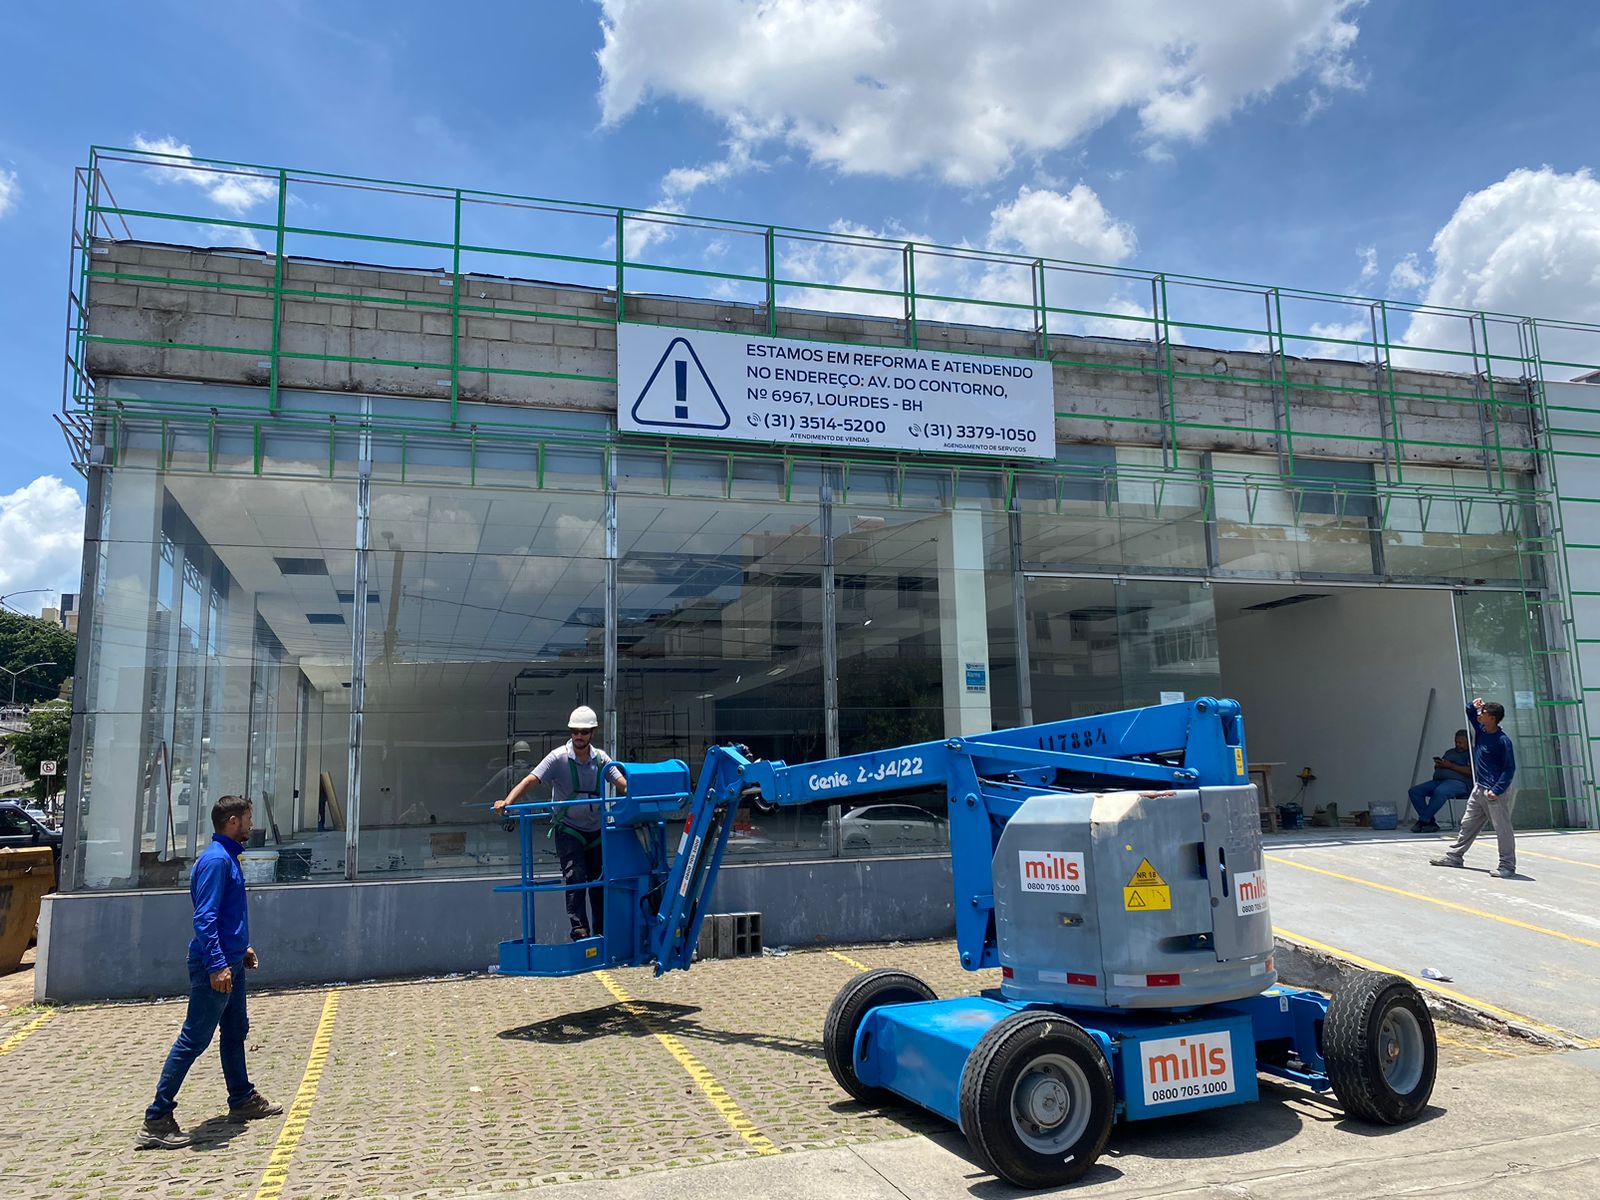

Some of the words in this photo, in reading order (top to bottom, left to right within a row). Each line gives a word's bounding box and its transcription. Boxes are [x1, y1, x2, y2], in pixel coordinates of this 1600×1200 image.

[746, 344, 823, 362] ESTAMOS
[827, 351, 850, 365] EM
[853, 353, 928, 370] REFORMA
[931, 359, 941, 372] E
[943, 361, 1033, 379] ATENDENDO
[746, 365, 772, 380] NO
[775, 368, 864, 388] ENDEREÇO:
[867, 375, 891, 389] AV.
[894, 377, 916, 391] DO
[919, 379, 1008, 399] CONTORNO,
[747, 387, 768, 401] Nº
[771, 389, 814, 407] 6967,
[817, 393, 890, 410] LOURDES
[902, 399, 923, 413] BH
[764, 412, 795, 431] (31)
[799, 415, 886, 433] 3514-5200
[923, 422, 952, 440] (31)
[956, 425, 1037, 442] 3379-1050
[790, 432, 835, 441] ATENDIMENTO
[835, 435, 845, 443] DE
[845, 436, 870, 444] VENDAS
[943, 442, 989, 451] AGENDAMENTO
[988, 444, 998, 452] DE
[997, 445, 1027, 454] SERVIÇOS
[808, 771, 849, 791] Genie
[1024, 853, 1079, 880] mills
[1136, 871, 1147, 879] NR
[1027, 882, 1046, 891] 0800
[1046, 883, 1061, 892] 705
[1061, 884, 1081, 893] 1000
[1239, 872, 1267, 902] mills
[1148, 1038, 1226, 1084] mills
[1152, 1087, 1179, 1102] 0800
[1180, 1084, 1201, 1097] 705
[1202, 1080, 1228, 1095] 1000
